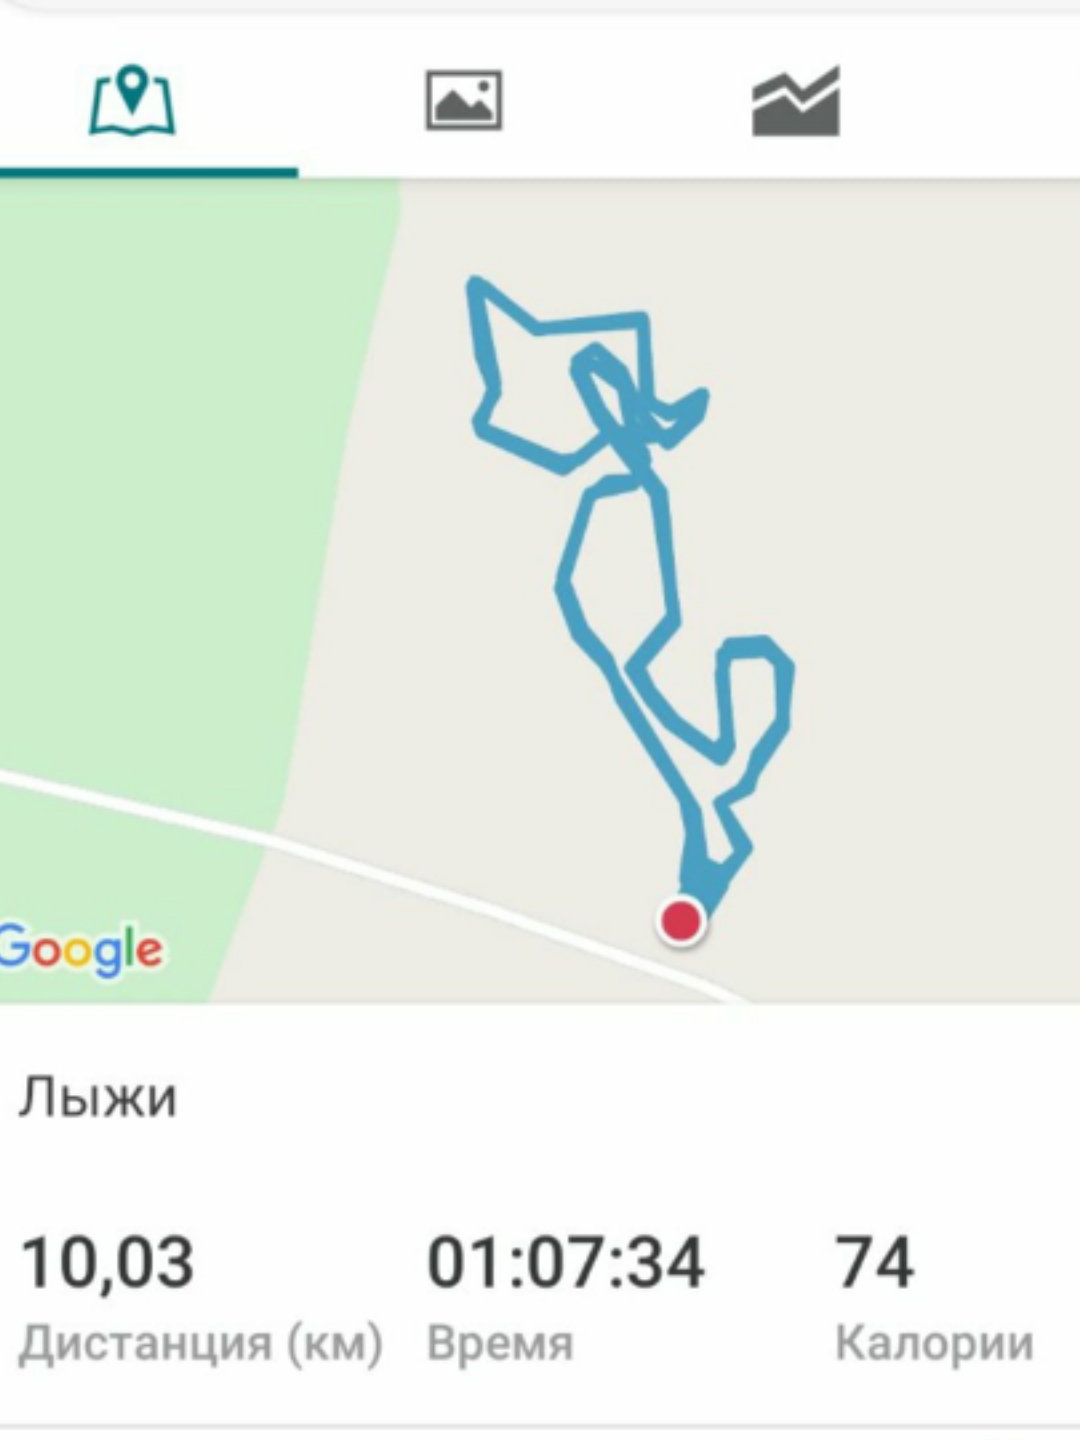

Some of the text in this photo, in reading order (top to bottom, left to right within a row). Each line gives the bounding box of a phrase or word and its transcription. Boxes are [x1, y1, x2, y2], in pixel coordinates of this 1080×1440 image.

[0, 921, 164, 980] Google
[18, 1073, 177, 1118] Лыжи
[21, 1232, 195, 1299] 10,03
[428, 1232, 706, 1290] 01:07:34
[834, 1233, 916, 1289] 74
[17, 1321, 384, 1371] Дистанция (км)
[428, 1323, 573, 1371] Время
[836, 1323, 1034, 1371] Калории
